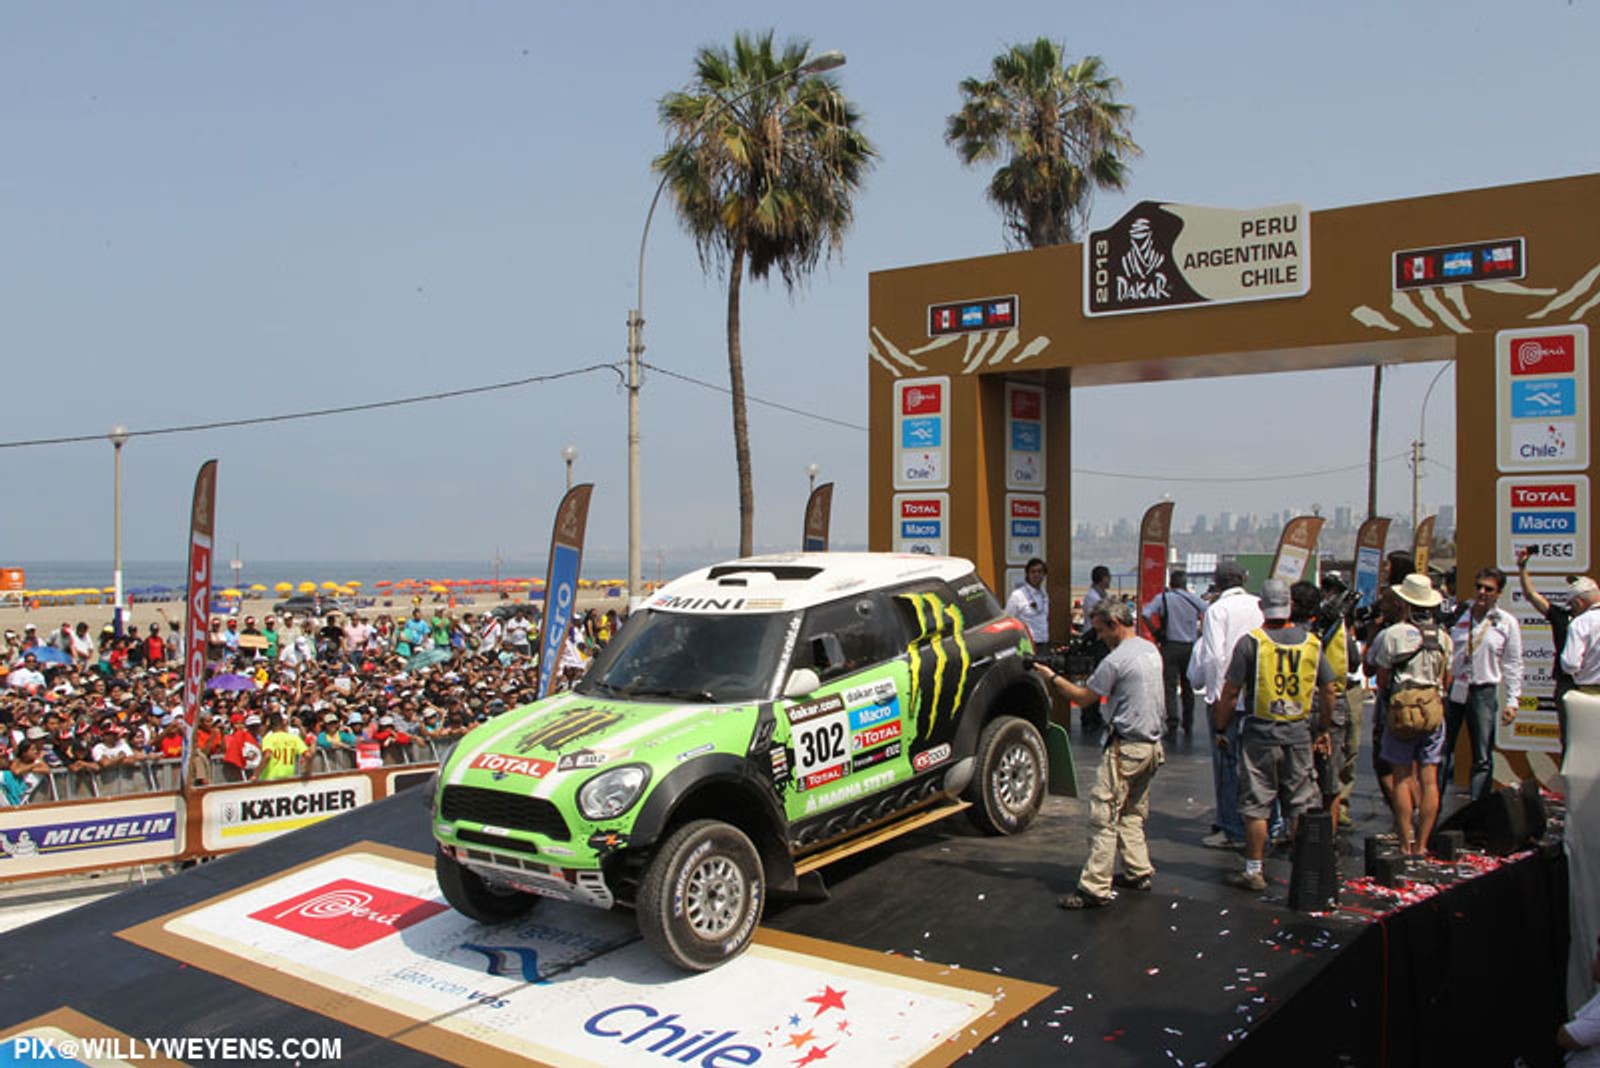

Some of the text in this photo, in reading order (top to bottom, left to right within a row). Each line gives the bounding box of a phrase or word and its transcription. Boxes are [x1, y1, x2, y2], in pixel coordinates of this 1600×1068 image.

[1241, 215, 1297, 238] PERU
[1183, 240, 1297, 270] ARGENTINA
[1095, 239, 1109, 303] 2013
[1241, 266, 1297, 287] CHILE
[1116, 272, 1170, 302] DAKAR
[1519, 443, 1557, 458] Chile
[906, 467, 929, 479] Chile
[1515, 489, 1572, 502] TOTAL
[904, 503, 937, 514] TOTAL
[905, 523, 936, 535] Macro
[1518, 515, 1568, 530] Macro
[664, 596, 745, 610] MINI
[187, 553, 208, 706] TOTAL
[1274, 648, 1301, 673] TV
[846, 682, 893, 704] dakar.com
[1274, 674, 1299, 697] 93
[790, 699, 842, 721] dakar.com
[859, 706, 891, 725] Macro
[801, 722, 846, 768] 302
[864, 725, 900, 745] TOTAL
[478, 754, 543, 776] TOTAL
[581, 754, 606, 764] 302
[809, 769, 841, 785] TOTAL
[240, 789, 357, 822] KÄRCHER
[42, 816, 173, 847] MICHELIN
[274, 889, 402, 927] Perú
[467, 989, 511, 1010] vos
[583, 1003, 762, 1068] Chile
